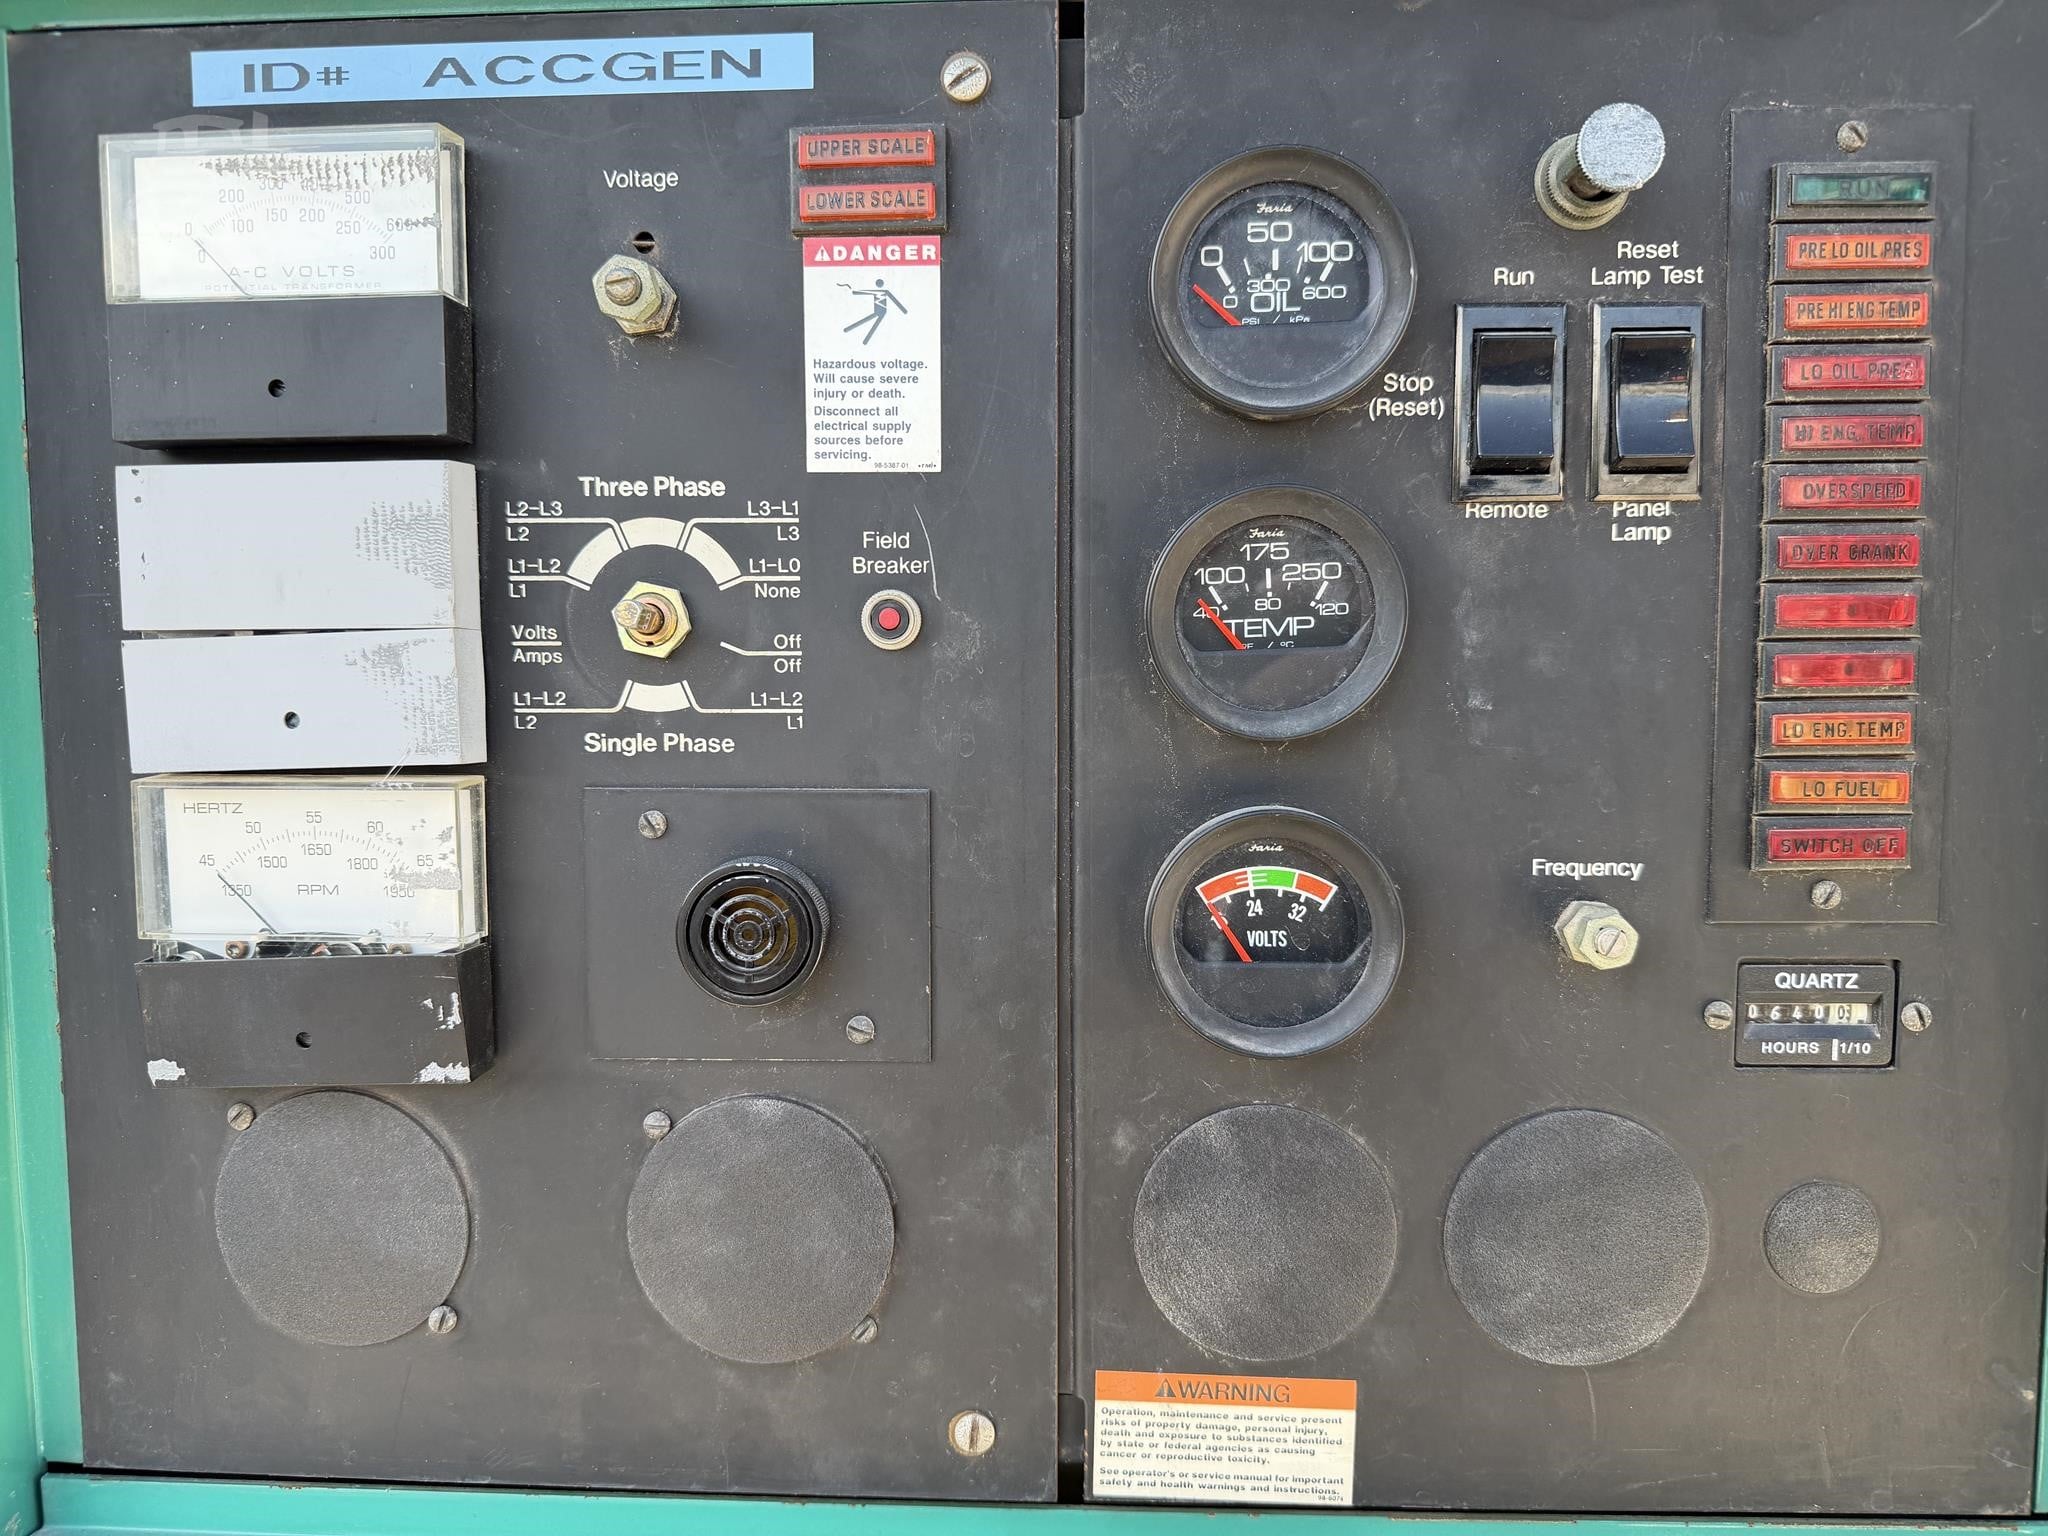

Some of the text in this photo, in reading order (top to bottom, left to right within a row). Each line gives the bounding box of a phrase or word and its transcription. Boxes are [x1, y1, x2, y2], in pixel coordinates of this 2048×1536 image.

[243, 48, 763, 93] ID# ACCGEN
[807, 137, 925, 157] UPPER SCALE
[602, 168, 680, 189] Voltage
[218, 188, 245, 204] 200
[1838, 179, 1890, 198] RUN
[345, 190, 371, 205] 500
[807, 188, 926, 211] LOWER SCALE
[266, 207, 288, 222] 150
[299, 208, 326, 223] 200
[231, 218, 254, 233] 100
[335, 220, 361, 235] 250
[1246, 221, 1293, 243] 50
[369, 245, 396, 260] 300
[832, 244, 937, 262] DANGER
[1200, 246, 1223, 267] 0
[1296, 241, 1353, 263] 100
[1617, 240, 1679, 259] Reset
[1799, 240, 1923, 259] PRE LO OIL PRES
[230, 265, 356, 278] A-C VOLTS
[1493, 267, 1535, 285] Run
[1590, 265, 1704, 289] Lamp Test
[1246, 278, 1291, 293] 300
[1302, 286, 1347, 300] 600
[1222, 295, 1238, 309] 0
[1250, 291, 1301, 313] OIL
[1796, 300, 1921, 319] PRE HI ENG TEMP
[813, 358, 928, 372] Hazardous voltage.
[1801, 361, 1914, 381] LO OIL PRES
[813, 373, 919, 384] Will cause severe
[1383, 373, 1434, 396] Stop
[813, 388, 906, 401] injury or death.
[814, 406, 898, 417] Disconnect all
[1368, 397, 1445, 422] (Reset)
[814, 421, 912, 433] electrical supply
[1794, 423, 1916, 442] HI TEMP
[814, 435, 904, 445] sources before
[814, 449, 872, 462] servicing.
[578, 476, 726, 497] Three Phase
[1802, 482, 1906, 500] OVERSPEED
[505, 500, 563, 517] L2-L3
[747, 500, 800, 517] L3-L1
[1464, 502, 1549, 519] Remote
[1612, 500, 1672, 518] Panel
[505, 526, 530, 542] L2
[776, 525, 800, 542] L3
[862, 531, 911, 550] Field
[1610, 522, 1673, 545] Lamp
[1239, 541, 1290, 562] 175
[1791, 543, 1910, 561] OVER CRANK
[507, 557, 561, 573] L1-L2
[852, 556, 930, 575] Breaker
[1281, 561, 1342, 581] 250
[1193, 566, 1246, 585] 100
[508, 583, 527, 599] L1
[754, 582, 801, 599] None
[1254, 597, 1282, 611] 80
[1315, 602, 1349, 616] 120
[511, 624, 558, 640] Volts
[1222, 616, 1316, 639] TEMP
[773, 633, 802, 649] Off
[512, 648, 563, 666] Amps
[773, 657, 802, 673] Off
[513, 691, 567, 707] L1-L2
[750, 691, 803, 707] L1-L2
[514, 715, 537, 730] L2
[786, 715, 803, 730] L1
[1782, 721, 1905, 738] LO TEMP
[583, 732, 736, 757] Single Phase
[1802, 781, 1880, 798] LO FUEL
[183, 802, 244, 814] HERTZ
[306, 810, 322, 824] 55
[245, 821, 262, 834] 50
[367, 820, 384, 834] 60
[301, 843, 332, 857] 1650
[1780, 837, 1900, 854] SWITCH OFF
[199, 854, 216, 867] 45
[257, 856, 288, 869] 1500
[347, 857, 378, 871] 1800
[417, 854, 434, 868] 65
[1531, 858, 1645, 881] Frequency
[222, 884, 252, 898] 1350
[297, 884, 340, 896] RPM
[1246, 898, 1264, 917] 24
[1287, 903, 1307, 923] 32
[1246, 930, 1288, 947] VOLTS
[1774, 971, 1860, 990] QUARTZ
[1761, 1041, 1820, 1055] HOURS
[1177, 1379, 1291, 1403] WARNING
[1101, 1407, 1343, 1425] Operation, maintenance and service present
[1100, 1418, 1291, 1434] risks property damage, personal
[1100, 1428, 1343, 1446] death and exposure substances identified
[1117, 1440, 1316, 1456] state federal agencies causing
[1099, 1450, 1271, 1465] cancer reproductive toxicity.
[1099, 1466, 1345, 1485] See operator's service manual for important
[1099, 1478, 1133, 1488] safety
[1160, 1480, 1194, 1489] health
[1198, 1482, 1246, 1492] warnings
[1250, 1484, 1270, 1492] and
[1273, 1485, 1340, 1495] instructions.
